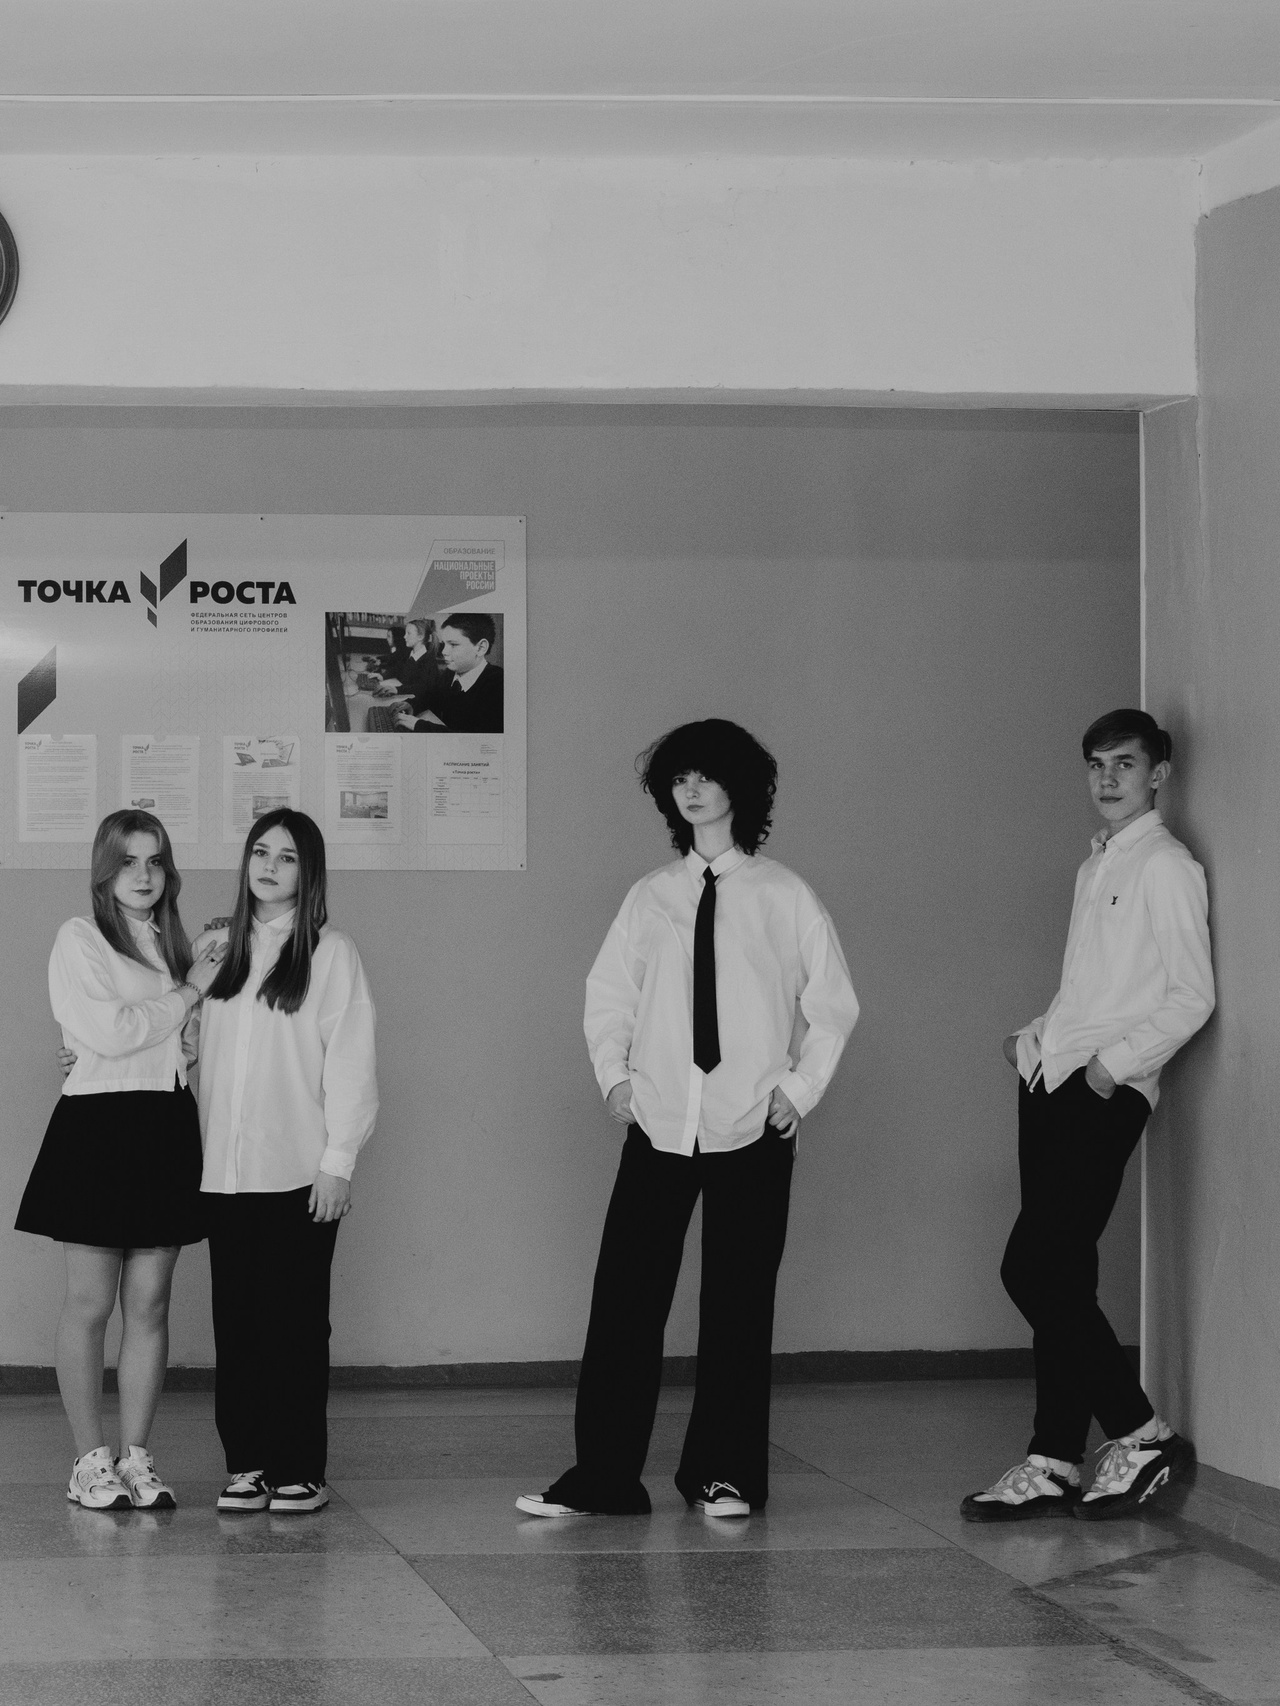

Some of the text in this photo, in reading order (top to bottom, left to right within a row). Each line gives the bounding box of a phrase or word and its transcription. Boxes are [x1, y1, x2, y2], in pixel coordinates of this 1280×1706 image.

[443, 547, 496, 555] ОБРАЗОВАНИЕ
[433, 561, 495, 571] НАЦИОНАЛЬНЫЕ
[460, 571, 495, 580] ПРОЕКТЫ
[466, 580, 495, 590] РОССИИ
[17, 579, 297, 605] ТОЧКА РОСТА
